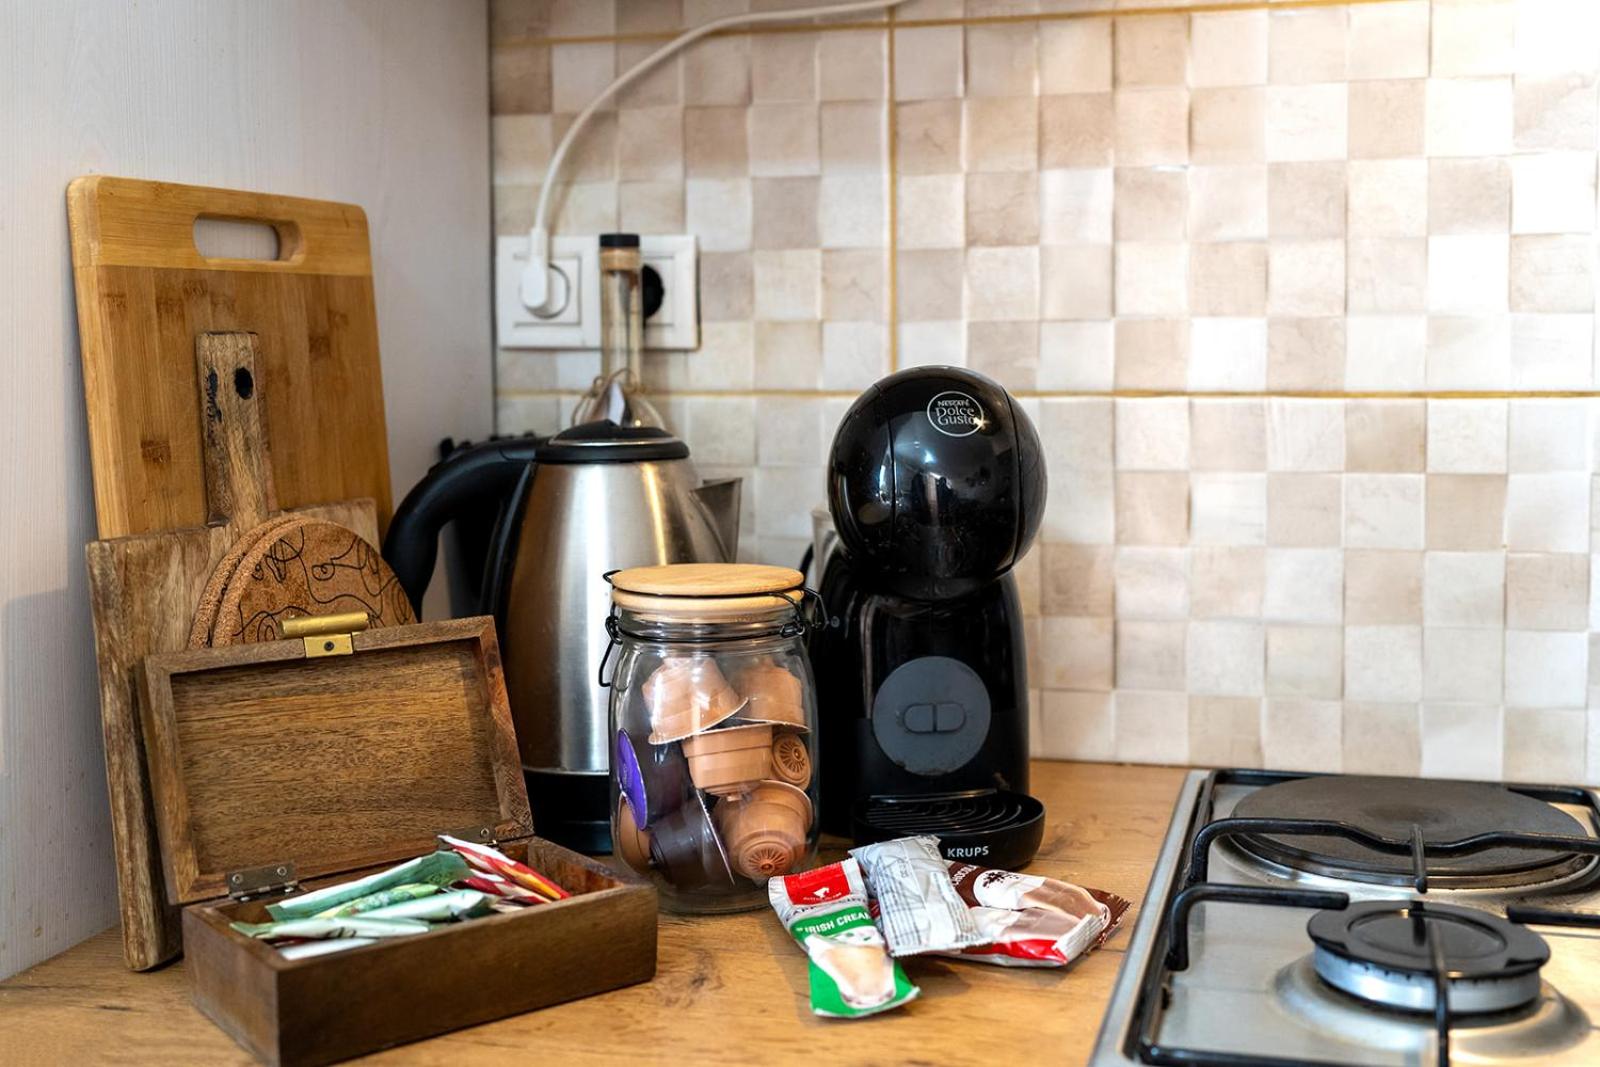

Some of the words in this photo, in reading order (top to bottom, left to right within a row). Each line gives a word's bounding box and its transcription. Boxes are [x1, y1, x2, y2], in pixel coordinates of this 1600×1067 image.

[935, 406, 975, 417] Dolce
[937, 414, 977, 425] Gusto
[947, 845, 990, 858] KRUPS
[804, 920, 836, 934] IRISH
